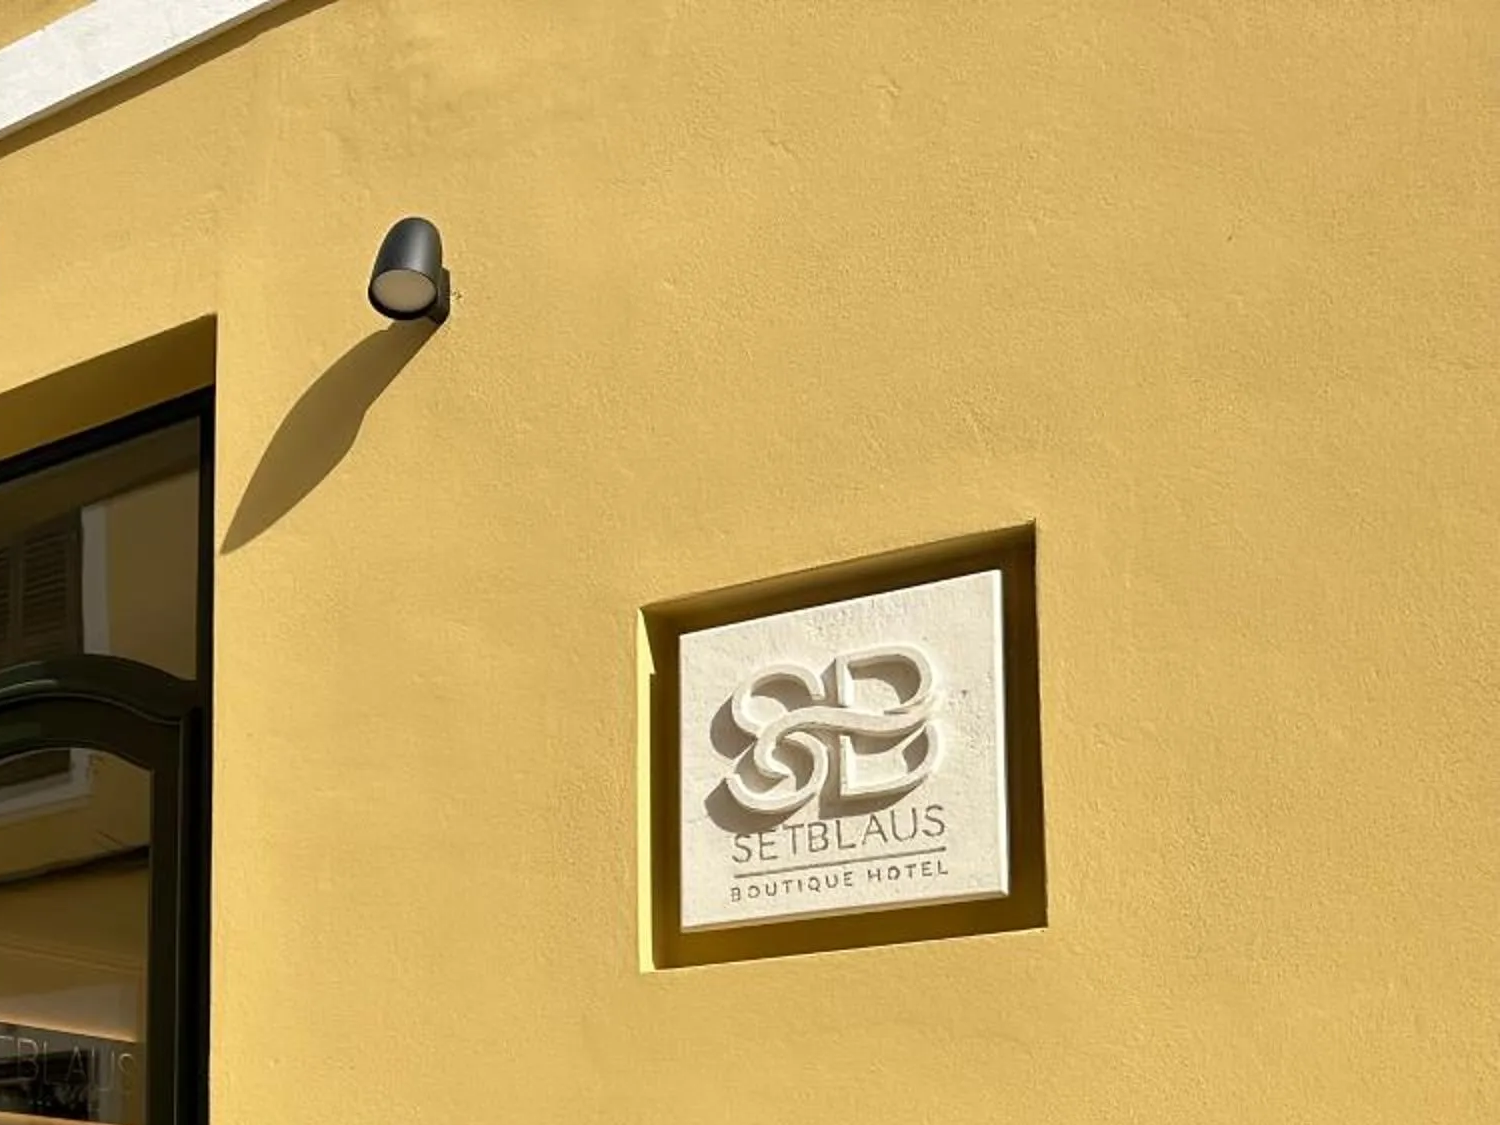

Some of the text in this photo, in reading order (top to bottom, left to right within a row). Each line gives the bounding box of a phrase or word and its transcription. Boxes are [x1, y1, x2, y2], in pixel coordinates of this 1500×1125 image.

[731, 803, 947, 864] SETBLAUS
[730, 859, 949, 903] BOUTIQUE HOTEL
